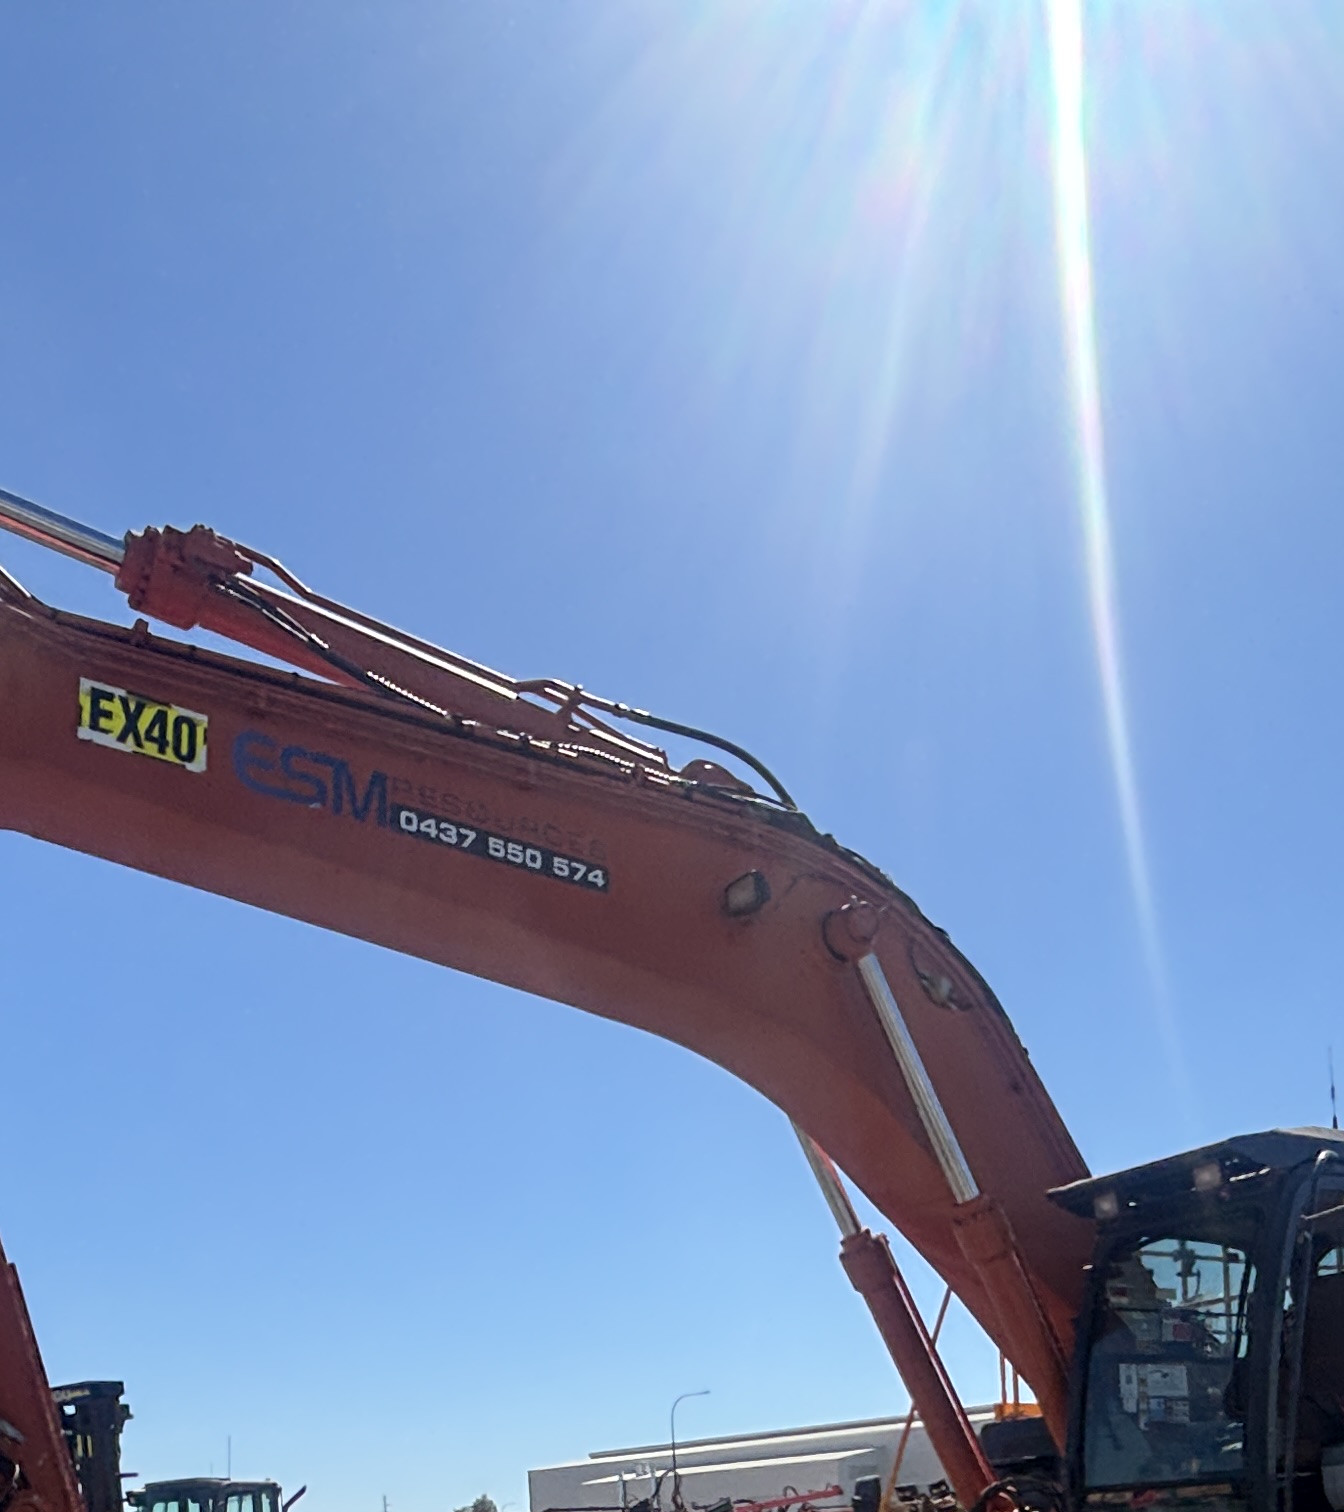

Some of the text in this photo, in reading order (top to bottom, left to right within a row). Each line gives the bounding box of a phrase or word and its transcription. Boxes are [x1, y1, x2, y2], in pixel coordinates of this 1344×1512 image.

[88, 687, 197, 763] EX40
[232, 729, 391, 827] ESM
[399, 809, 607, 888] 0437 550 574
